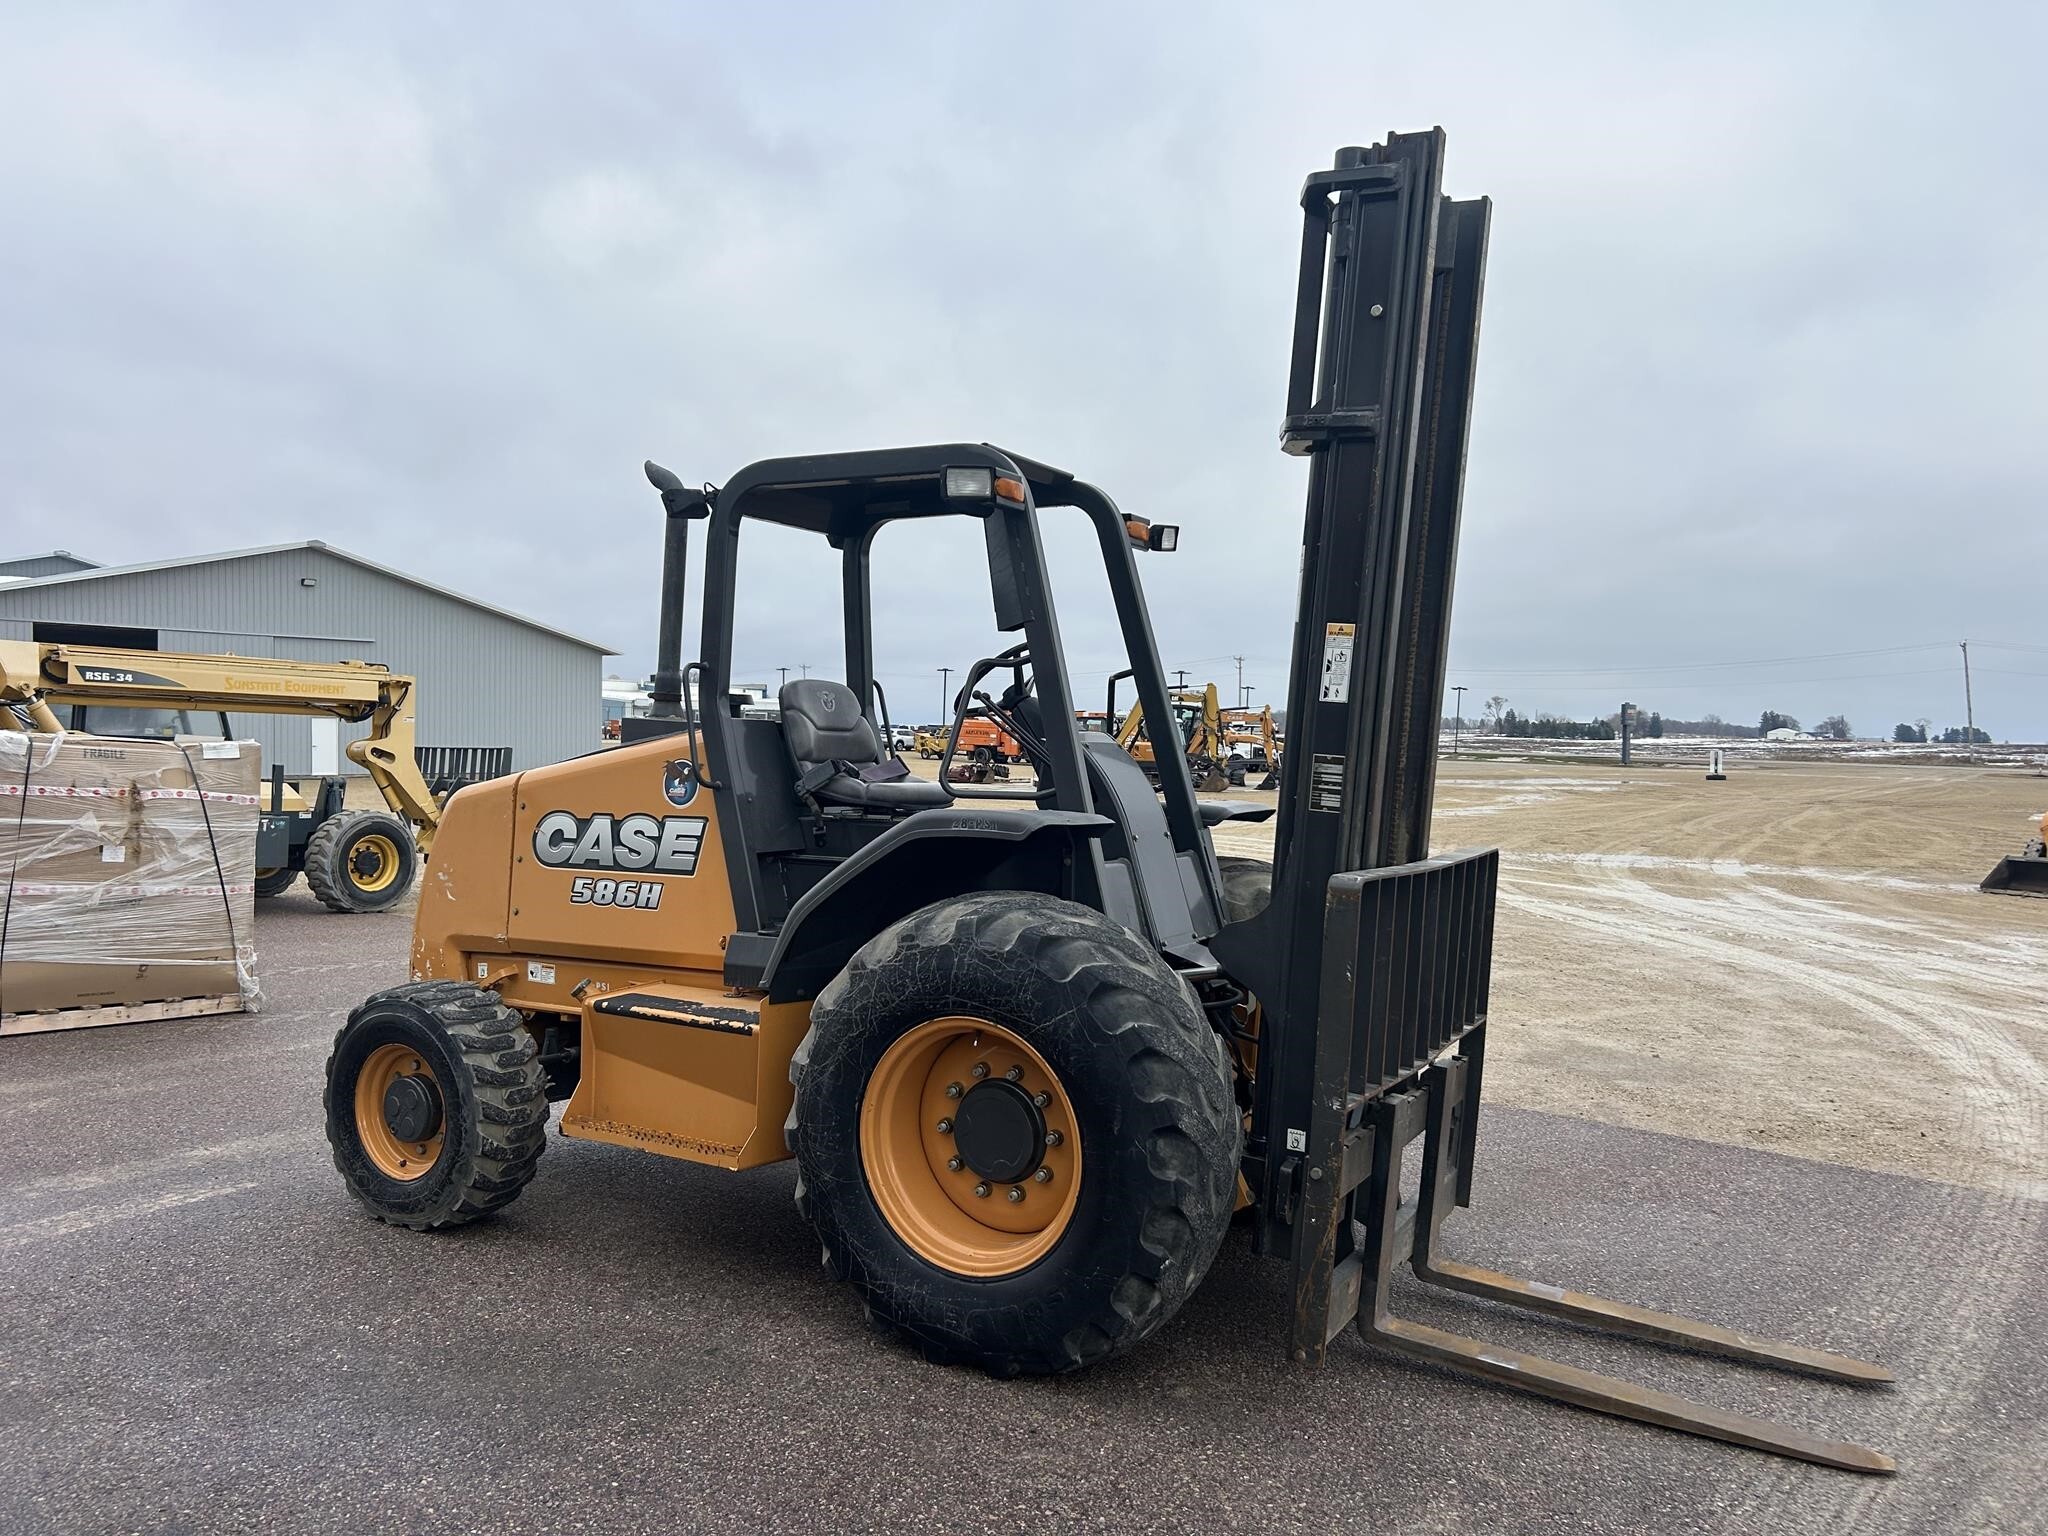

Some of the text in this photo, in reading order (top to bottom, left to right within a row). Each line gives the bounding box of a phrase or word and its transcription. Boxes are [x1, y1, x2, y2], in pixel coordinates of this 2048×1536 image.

[83, 748, 126, 760] FRAGILE
[534, 813, 706, 873] CASE
[571, 877, 662, 909] 586H
